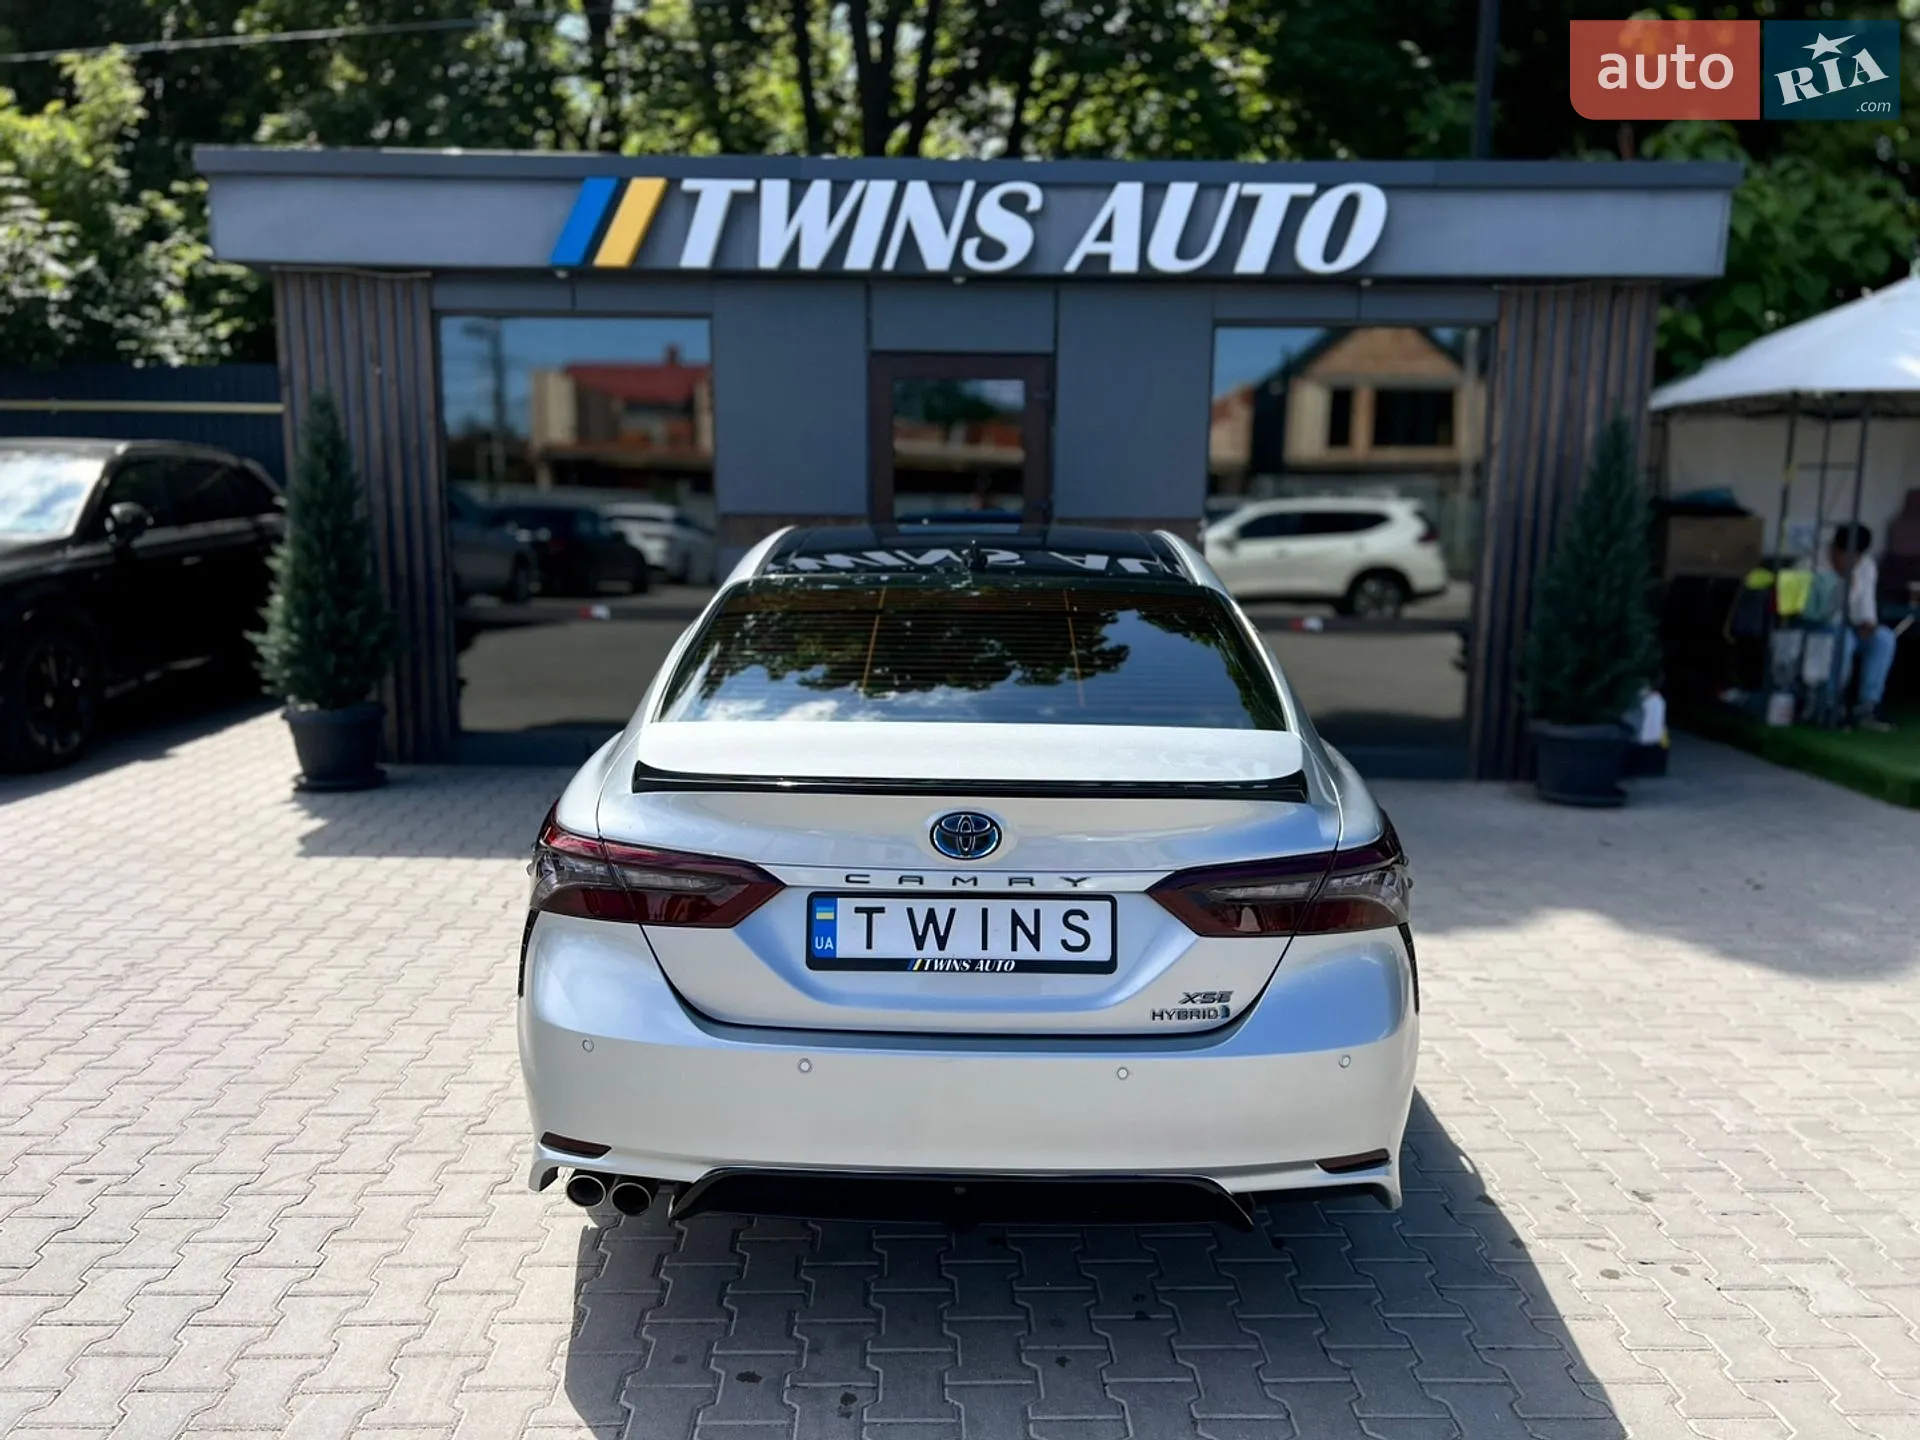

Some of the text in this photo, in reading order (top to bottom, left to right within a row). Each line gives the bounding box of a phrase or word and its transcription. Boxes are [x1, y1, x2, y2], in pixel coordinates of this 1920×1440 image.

[679, 178, 1389, 274] TWINS AUTO
[844, 873, 1092, 888] CAMRY
[854, 906, 1093, 953] TWINS
[815, 936, 834, 950] UA
[923, 958, 1016, 973] TWINS AUTO
[1178, 990, 1234, 1005] XSE
[1151, 1007, 1219, 1021] HYBRID
